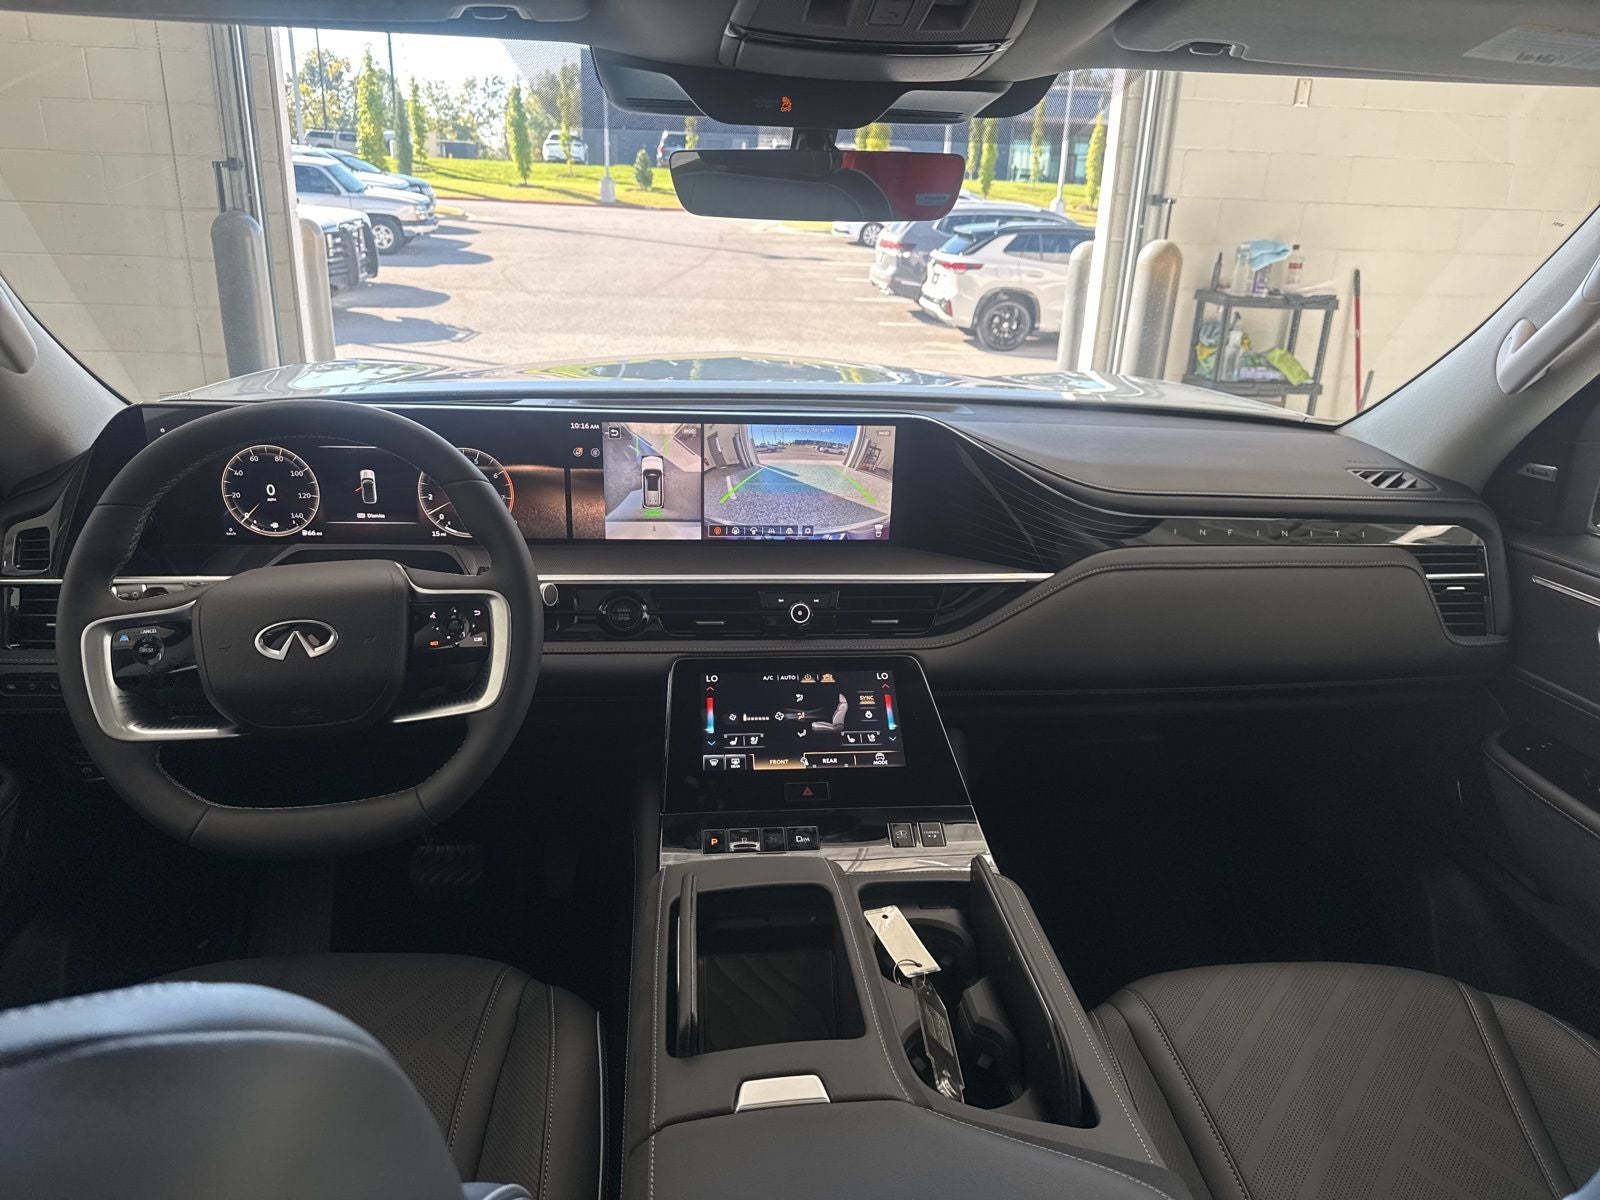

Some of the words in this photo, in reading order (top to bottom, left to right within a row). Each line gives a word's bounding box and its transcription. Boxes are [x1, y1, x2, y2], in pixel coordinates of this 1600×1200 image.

[570, 422, 589, 430] 10:16
[266, 483, 276, 496] 0
[1174, 528, 1365, 538] INFINITI
[706, 675, 718, 683] LO
[876, 672, 889, 680] LO
[711, 838, 718, 846] P
